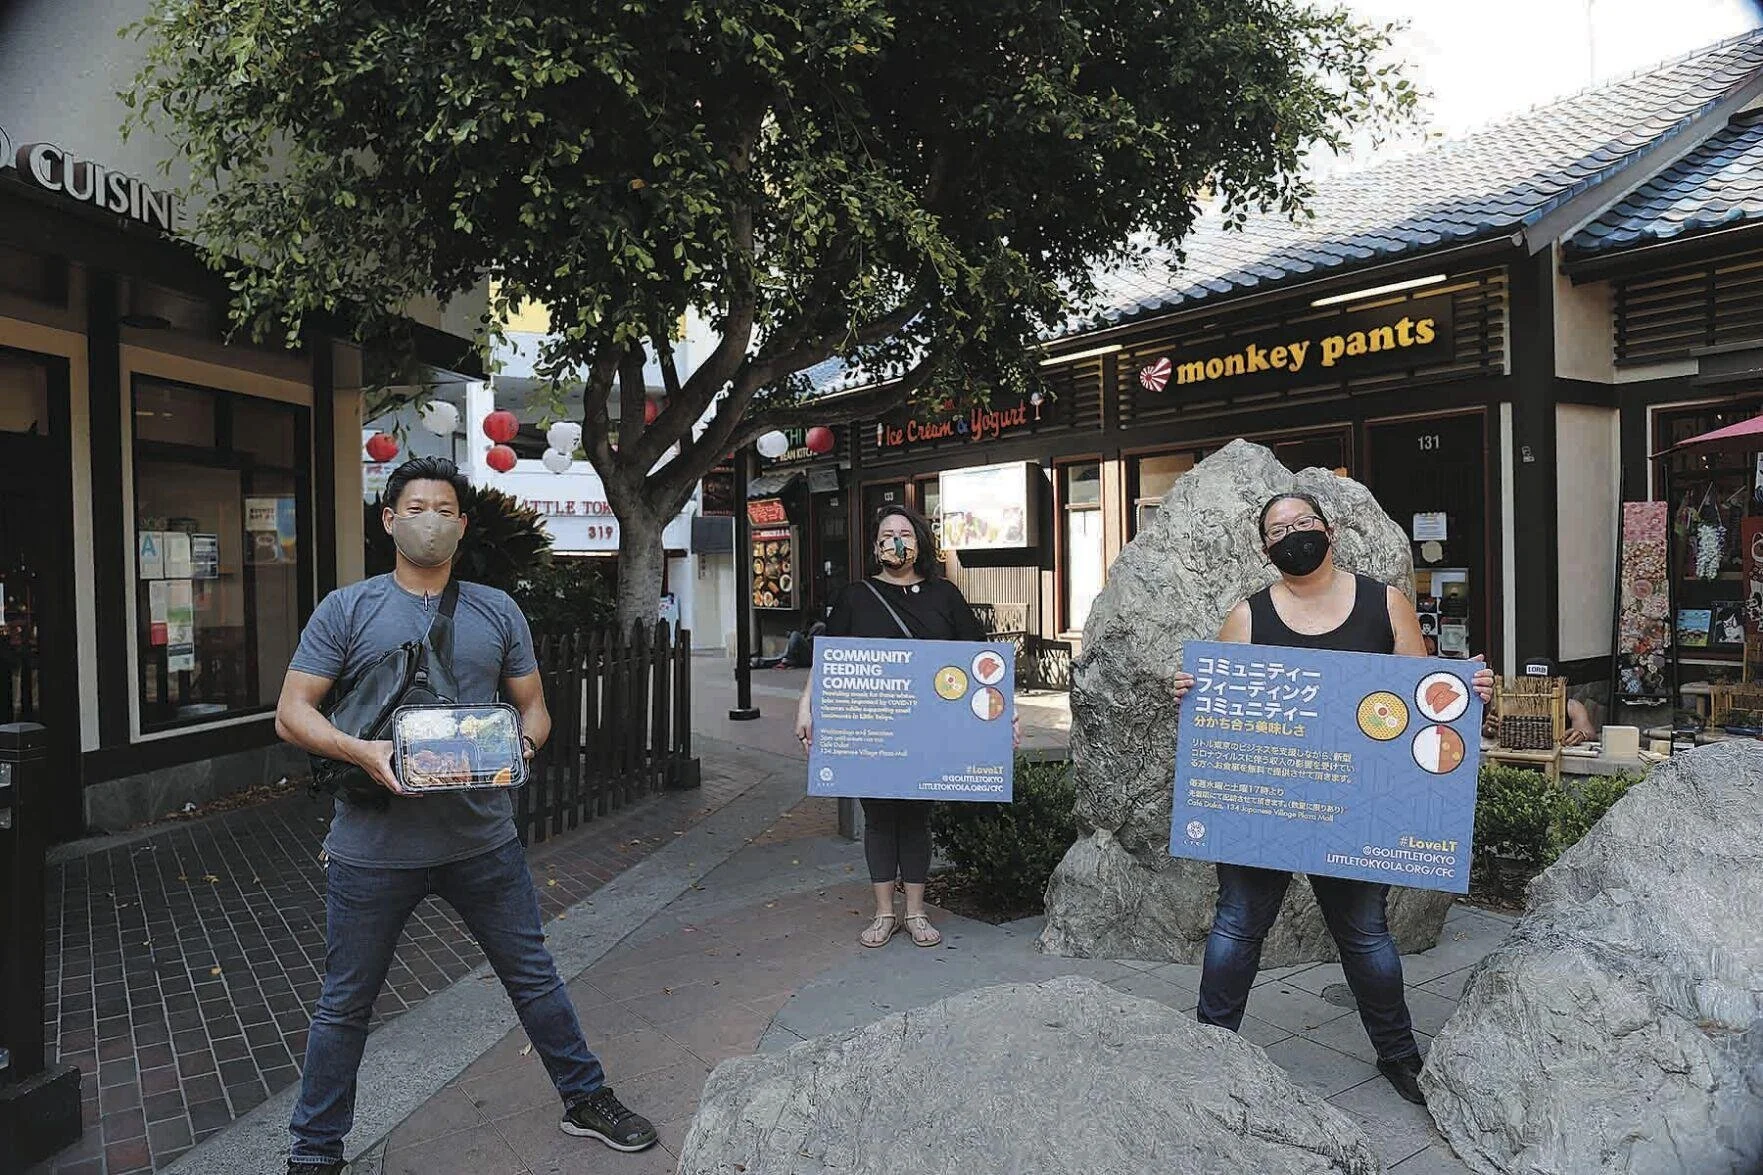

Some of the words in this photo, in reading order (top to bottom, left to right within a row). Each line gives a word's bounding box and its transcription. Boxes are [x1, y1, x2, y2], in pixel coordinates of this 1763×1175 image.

[1176, 341, 1310, 385] monkey
[1320, 316, 1436, 367] pants
[886, 424, 903, 446] Ice
[906, 419, 955, 443] Cream
[970, 400, 1027, 441] Yogurt
[1417, 434, 1440, 450] 131
[524, 500, 576, 514] ITTLE
[583, 501, 612, 514] TOK
[588, 525, 613, 539] 319
[141, 534, 157, 557] A
[823, 648, 913, 664] COMMUNITY
[823, 662, 883, 676] FEEDING
[1198, 657, 1320, 682] コミュニティー
[822, 677, 912, 692] COMMUNITY
[1196, 677, 1320, 703] フィーディング
[1195, 697, 1318, 722] コミュニティー
[1194, 715, 1306, 737] 分かち合う美味しさ
[1400, 836, 1458, 853] #LoveLT
[1326, 853, 1456, 879] LITTLETOKYOLA.ORG/CFC
[1362, 845, 1456, 866] @GOLITTLETOKYO
